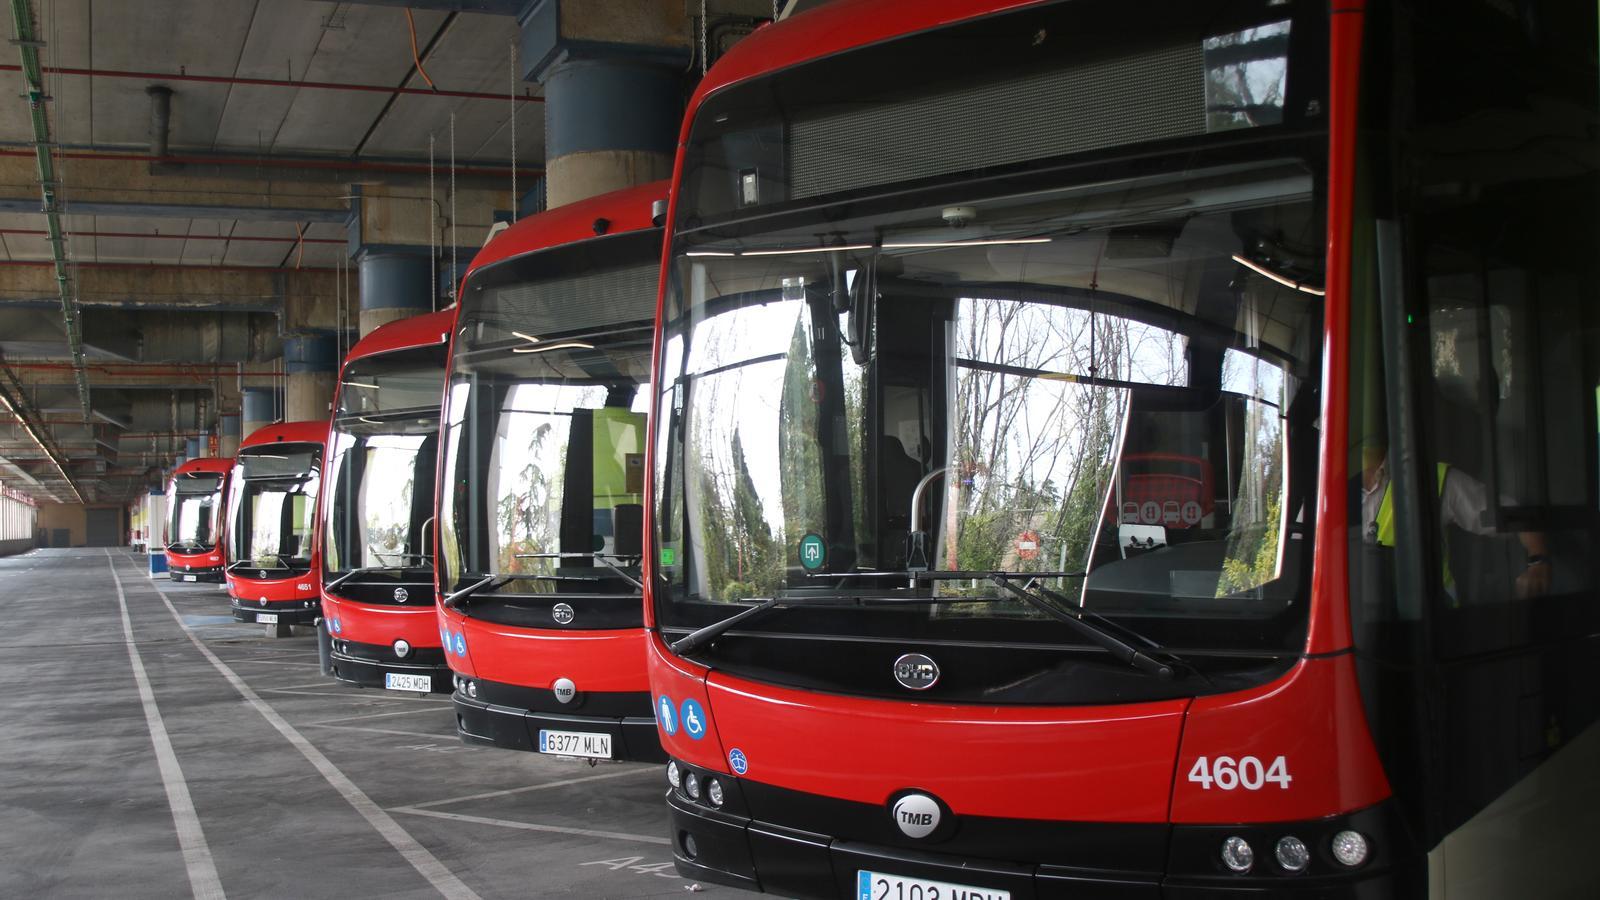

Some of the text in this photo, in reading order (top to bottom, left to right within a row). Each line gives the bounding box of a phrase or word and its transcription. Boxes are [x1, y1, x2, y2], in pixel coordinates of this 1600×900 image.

[898, 663, 934, 680] BYD
[391, 676, 411, 689] 2425
[556, 688, 572, 696] TMB
[548, 734, 609, 755] 6377 MLN
[1188, 756, 1292, 790] 4604
[901, 811, 932, 826] TMB
[577, 856, 683, 879] A4
